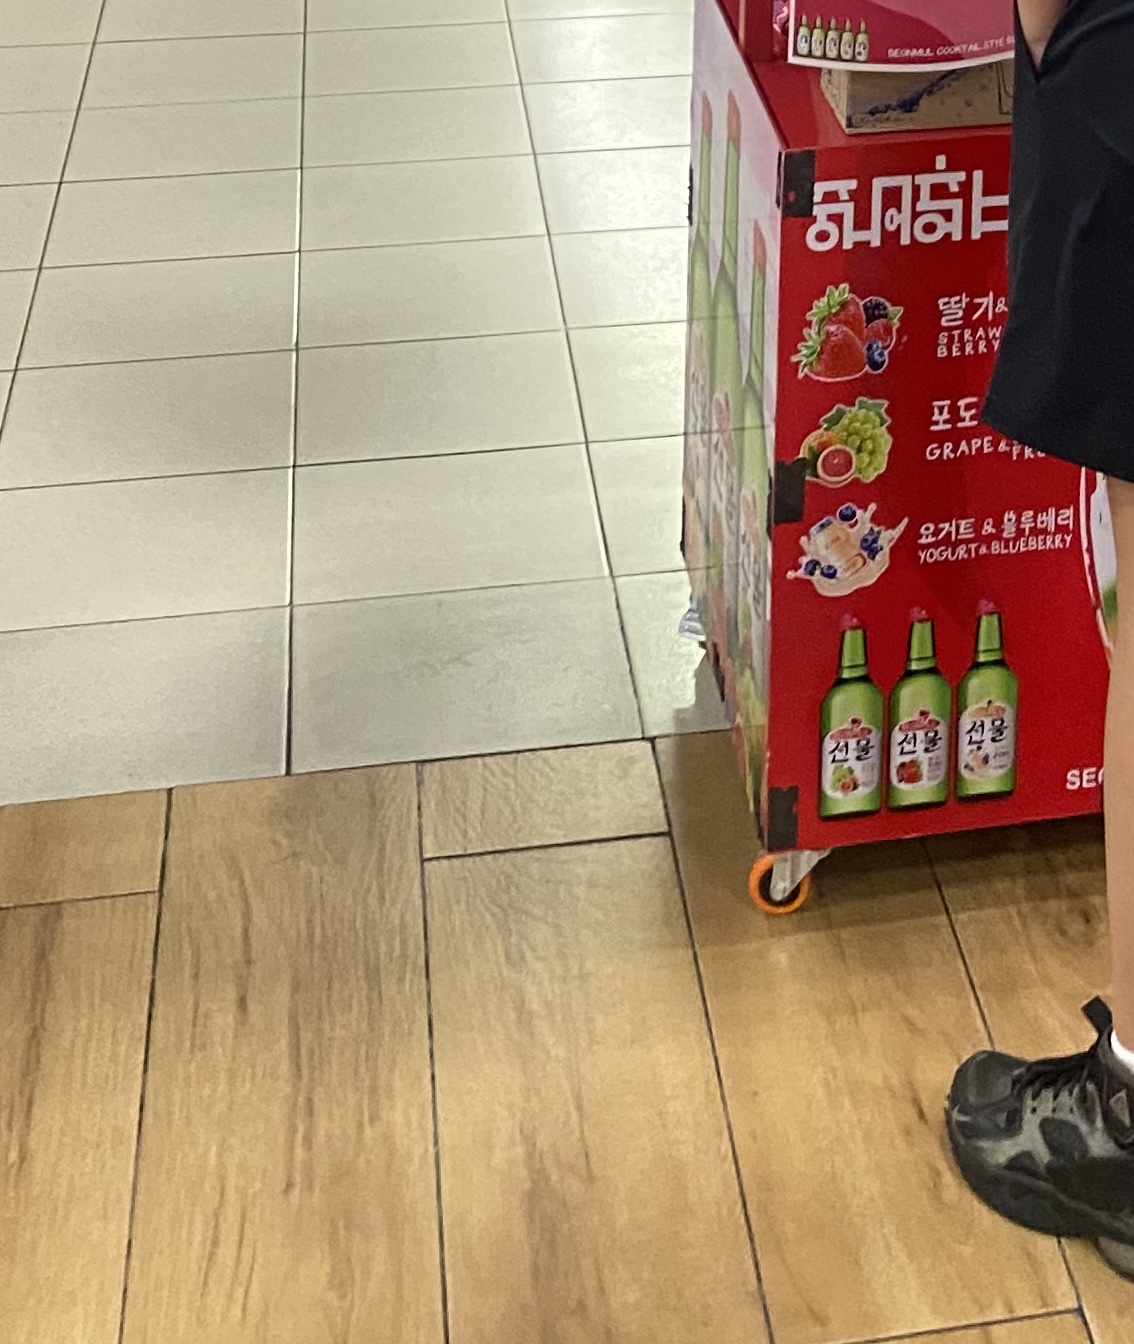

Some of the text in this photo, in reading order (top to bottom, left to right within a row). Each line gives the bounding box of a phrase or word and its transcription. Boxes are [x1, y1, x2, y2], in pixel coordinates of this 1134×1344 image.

[938, 326, 1002, 345] STRAW
[937, 339, 1000, 358] BERRY
[930, 397, 978, 431] 포도
[926, 436, 994, 461] GRAPE
[917, 518, 976, 544] 요거트
[982, 517, 996, 535] &
